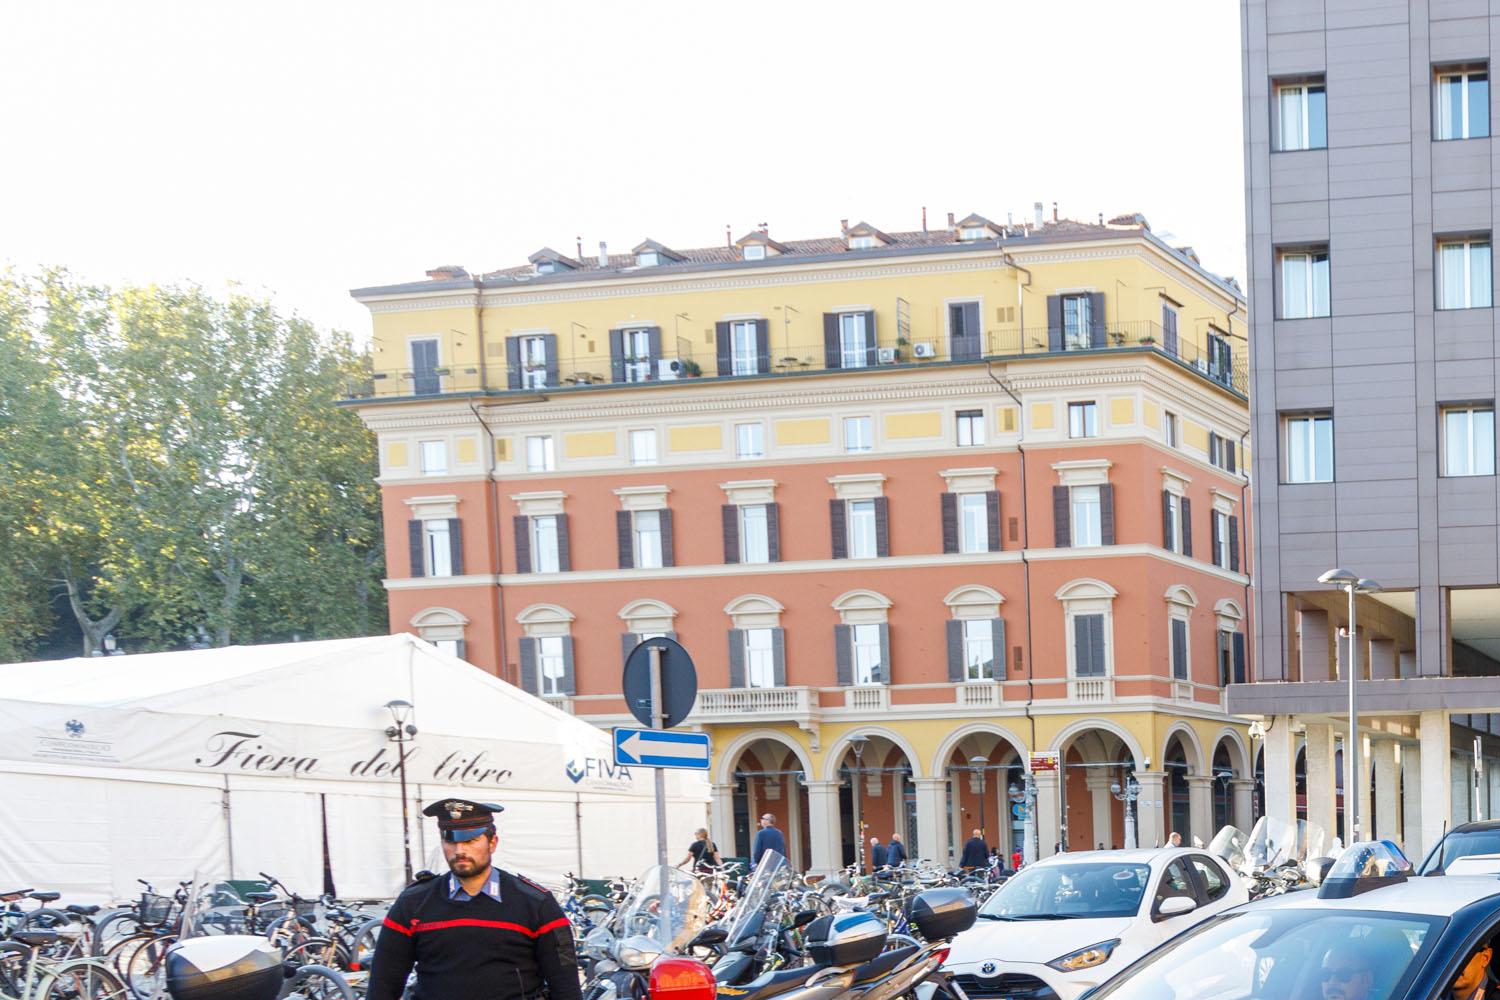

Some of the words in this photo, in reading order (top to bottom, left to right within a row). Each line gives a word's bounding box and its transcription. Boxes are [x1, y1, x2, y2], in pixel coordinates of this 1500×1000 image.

[196, 731, 321, 773] Fiera
[350, 748, 421, 777] del
[432, 750, 513, 784] libro
[585, 757, 632, 780] FIVA
